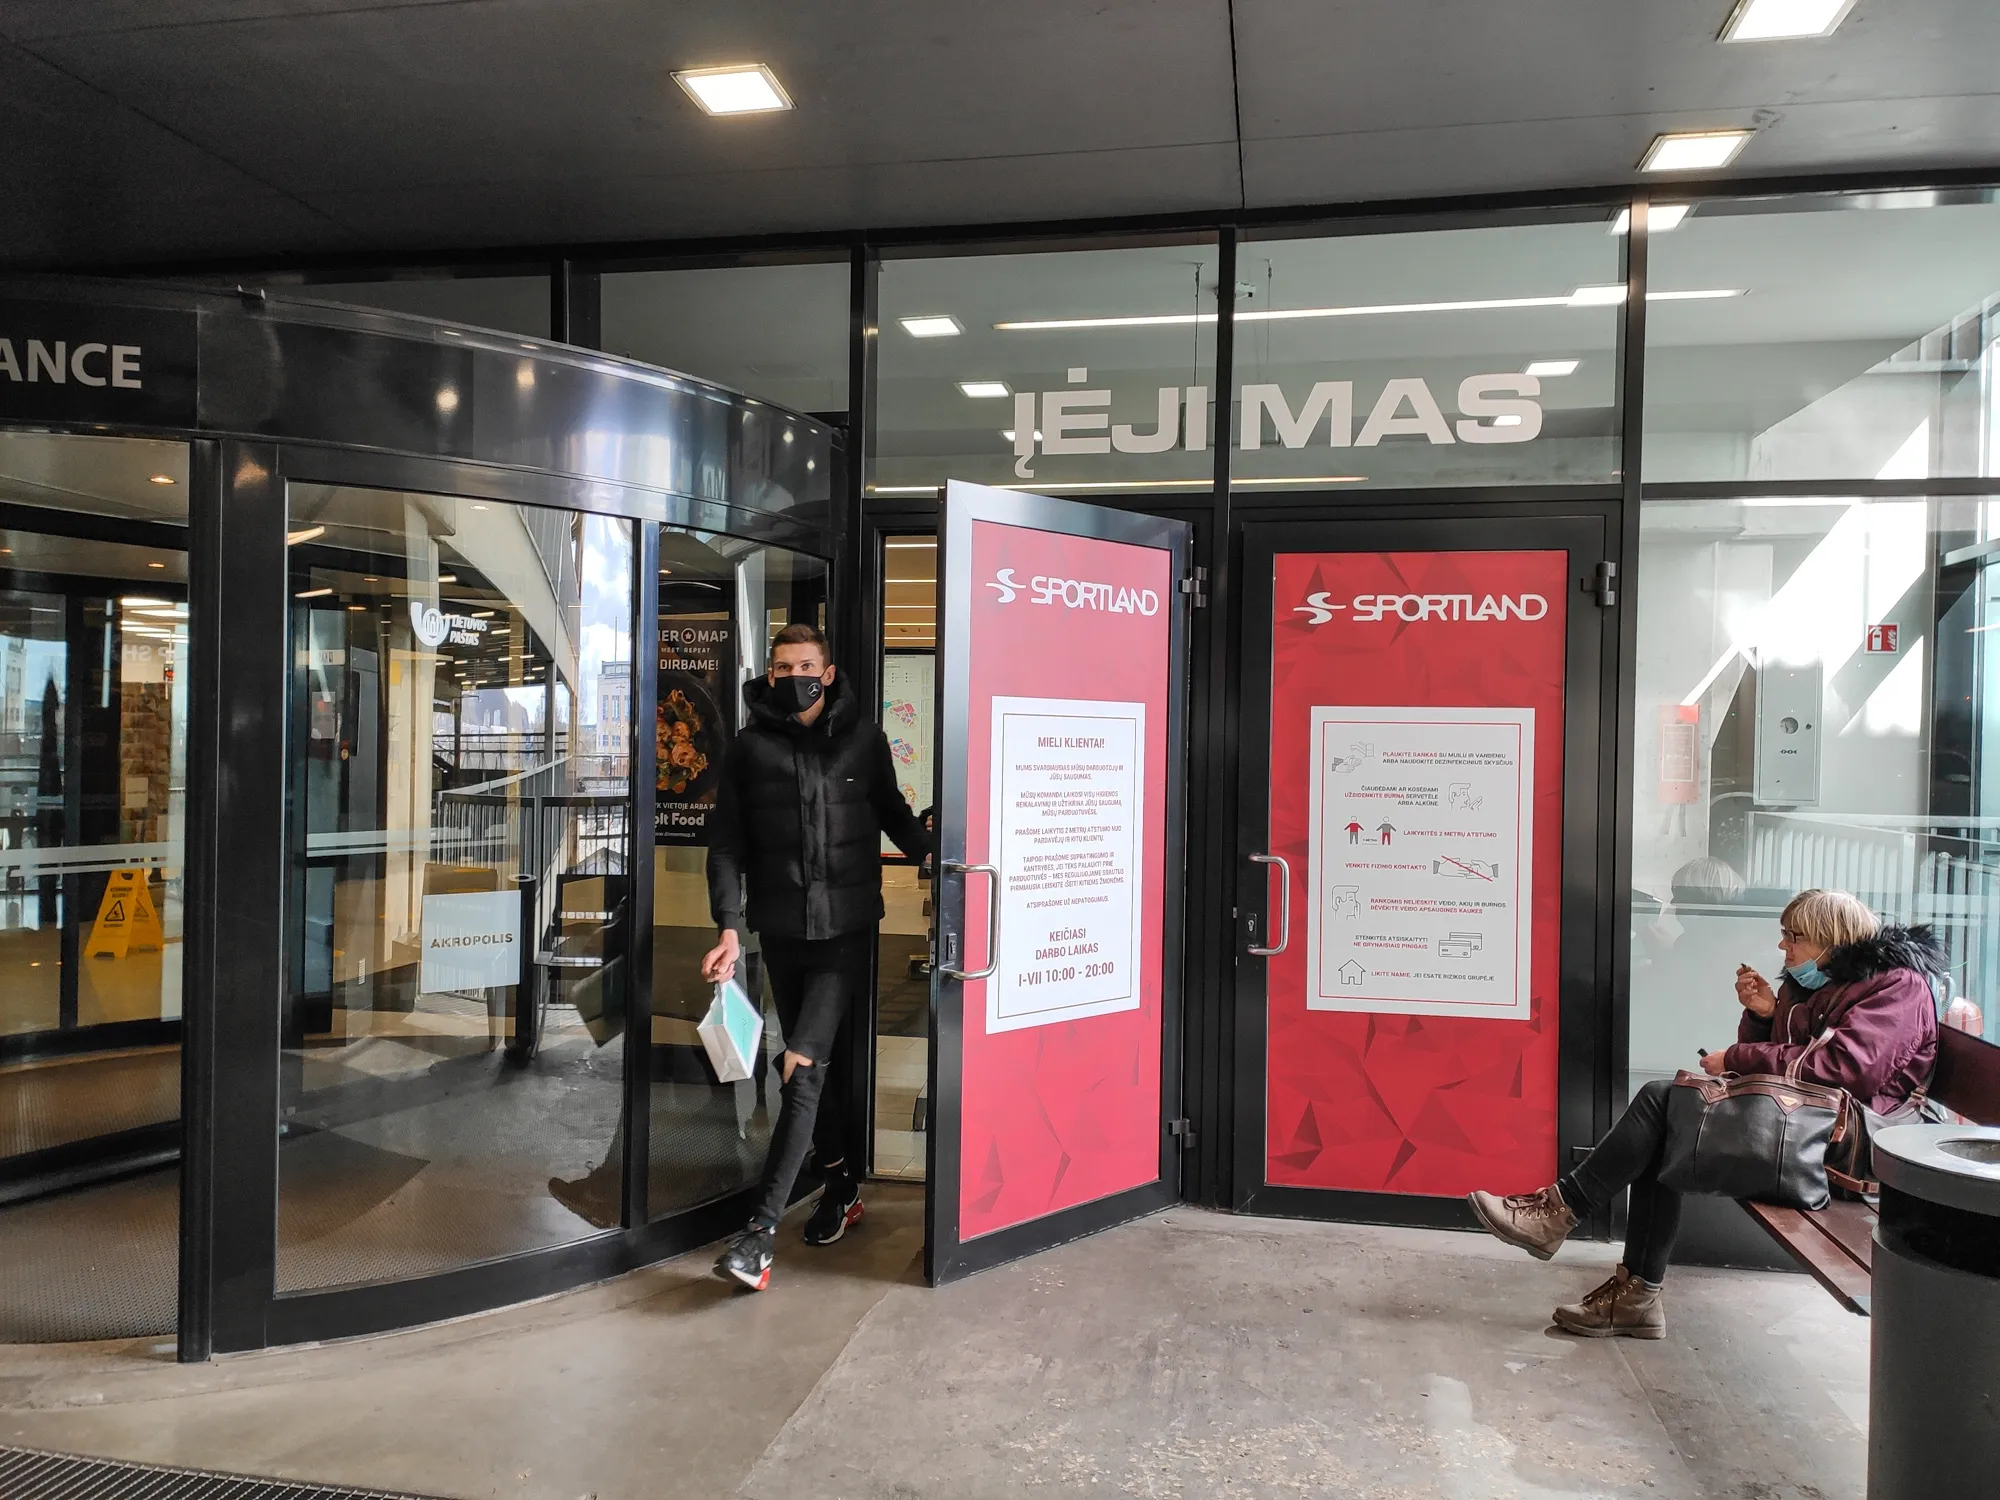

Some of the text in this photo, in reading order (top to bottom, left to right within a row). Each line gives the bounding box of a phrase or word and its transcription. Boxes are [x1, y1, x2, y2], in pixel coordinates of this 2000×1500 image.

[1031, 576, 1159, 617] SPORTLAND
[1352, 593, 1548, 623] SPORTLAND
[449, 629, 480, 646] PAŠTAS
[697, 630, 729, 643] MAP
[660, 658, 719, 671] DIRBAME!
[1037, 736, 1105, 749] MIELI KLIENTAI!
[1071, 763, 1085, 772] MŪSŲ
[1049, 773, 1063, 781] JŪSŲ
[1360, 784, 1397, 792] ČIAUDĖDAMI
[1020, 790, 1036, 799] MŪSŲ
[1084, 791, 1095, 799] VISŲ
[1344, 791, 1383, 799] UŽSIDENKITE
[1383, 792, 1405, 800] BURNĄ
[662, 802, 689, 811] VIETOJE
[1057, 799, 1084, 807] UŽTIKRINA
[1085, 798, 1098, 807] JŪSŲ
[1042, 808, 1057, 817] MŪSŲ
[671, 812, 705, 826] Food
[1015, 827, 1041, 835] PRAŠOME
[1443, 831, 1466, 839] METRŲ
[1034, 836, 1064, 844] PARDAVĖJŲ
[1044, 853, 1069, 862] PRAŠOME
[1009, 872, 1047, 882] PARDUOTUVĖS
[1079, 878, 1099, 886] KITIEMS
[1026, 899, 1063, 909] ATSIPRAŠOME
[1071, 896, 1109, 905] NEPATOGUMUS.
[1049, 927, 1086, 942] KEIČIASI
[430, 933, 513, 949] AKROPOLIS
[1035, 942, 1099, 960] DARBO LAIKAS
[1018, 971, 1042, 987] I-VII
[1045, 966, 1075, 983] 10:00
[1085, 961, 1114, 978] 20:00
